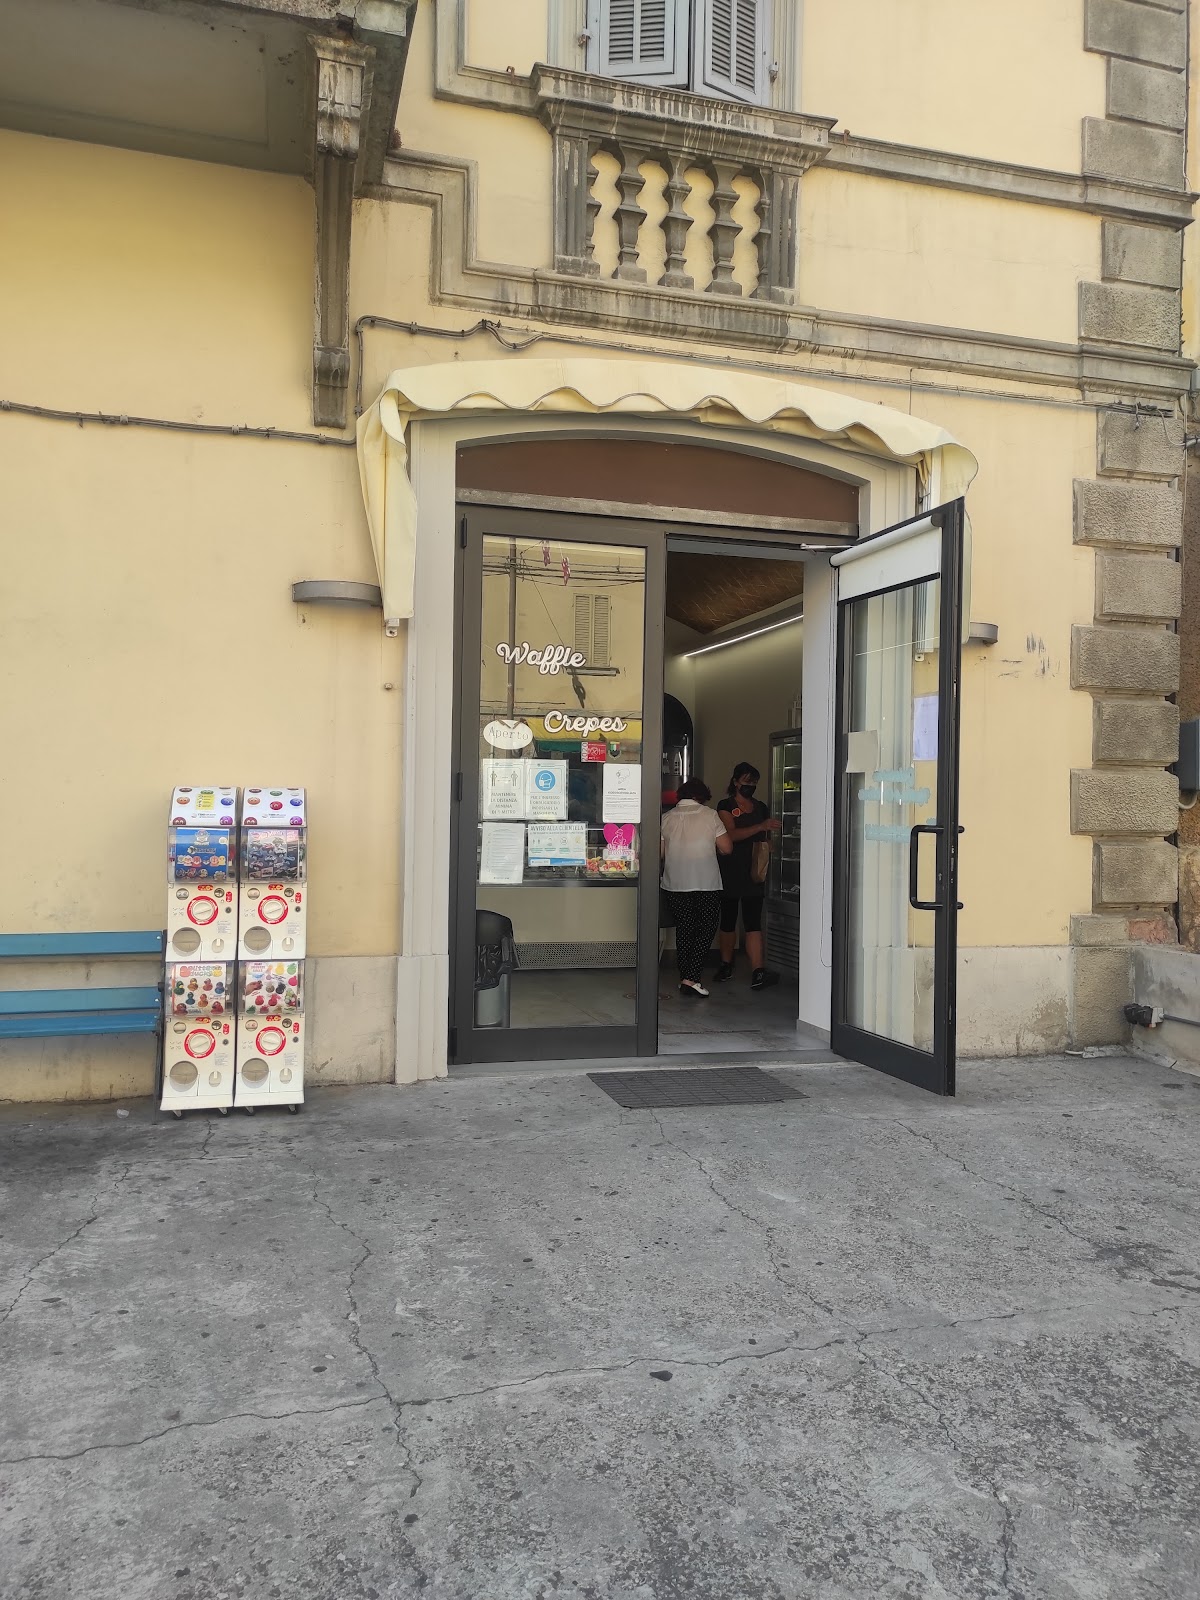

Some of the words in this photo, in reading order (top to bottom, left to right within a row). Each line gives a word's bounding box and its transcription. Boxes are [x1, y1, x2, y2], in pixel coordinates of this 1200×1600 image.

[496, 642, 586, 675] Waffle
[489, 726, 529, 740] Aperto
[543, 710, 628, 738] Crepes
